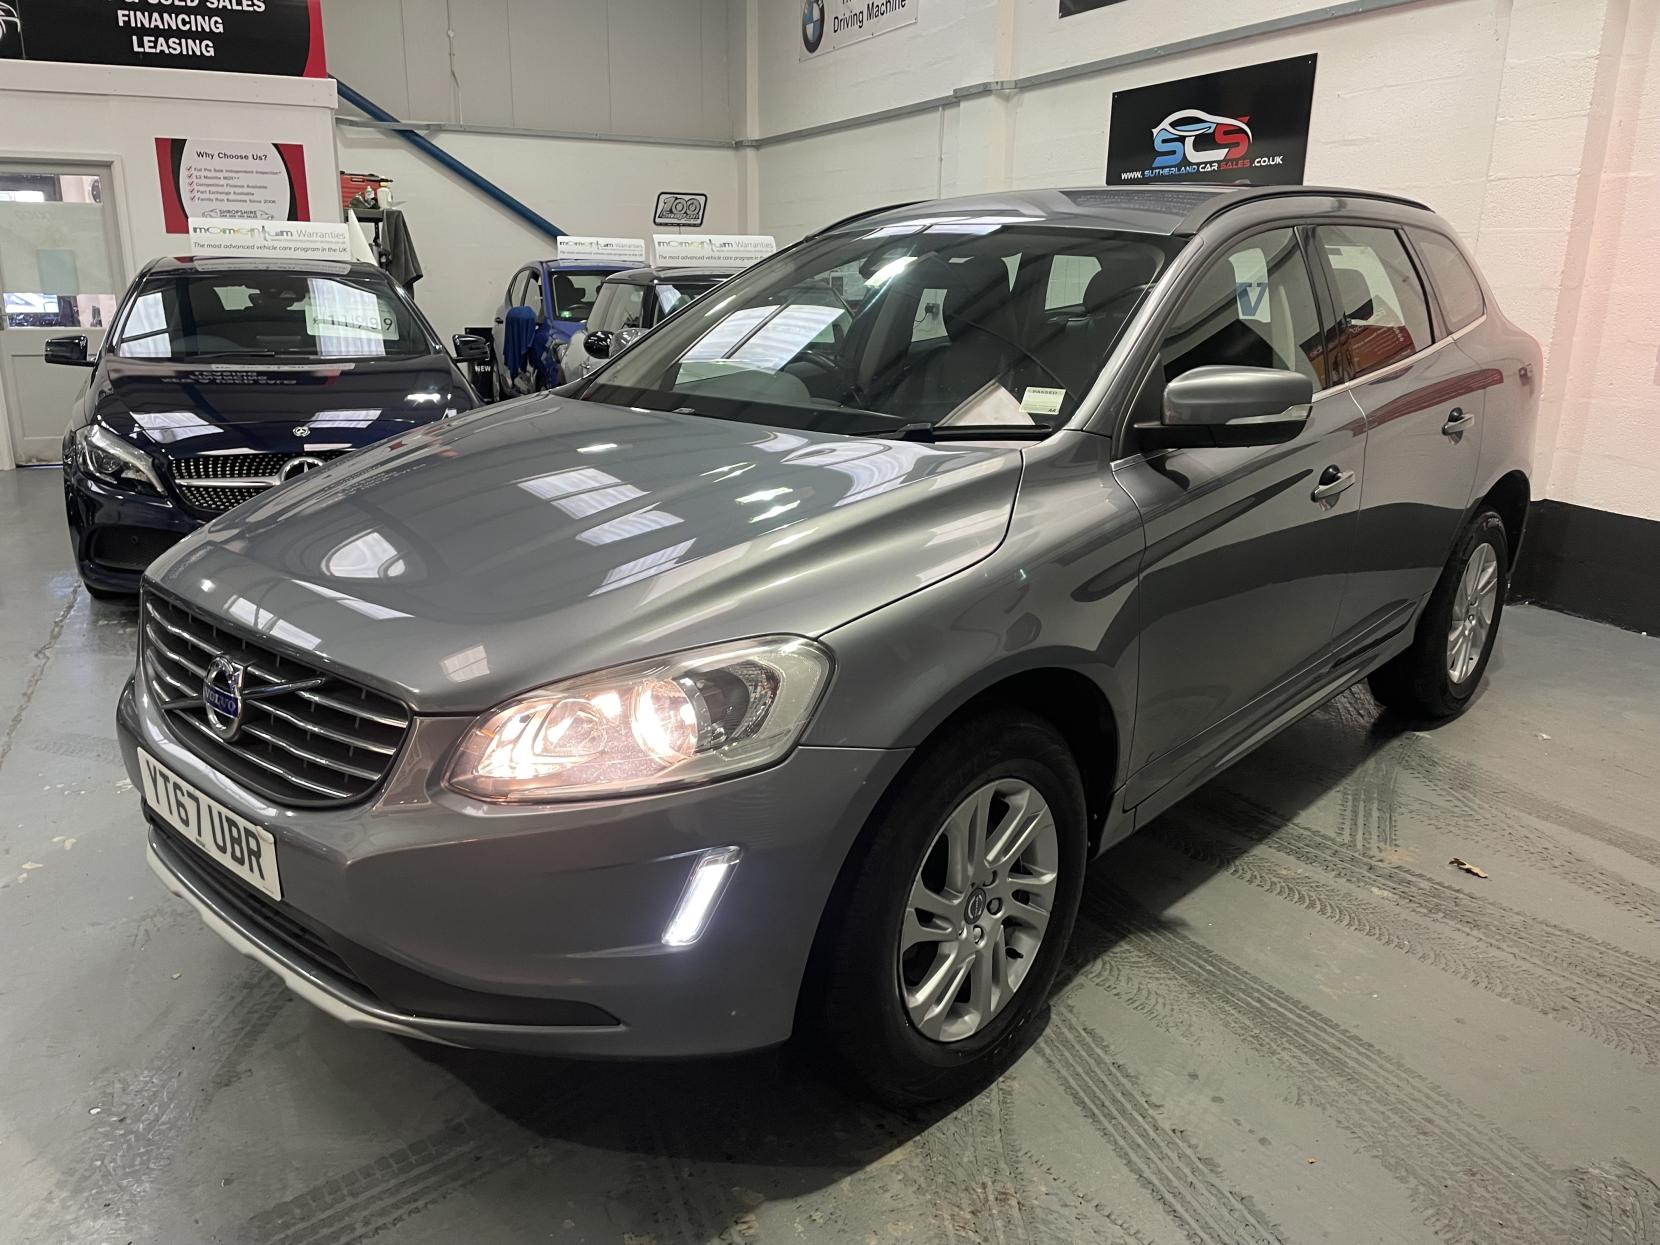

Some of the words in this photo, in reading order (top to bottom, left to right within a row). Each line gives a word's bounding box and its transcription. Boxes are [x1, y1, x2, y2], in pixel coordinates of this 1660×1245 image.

[206, 0, 266, 12] SALES
[833, 10, 863, 33] Driving
[866, 0, 906, 21] Machine
[117, 9, 224, 33] FINANCING
[132, 35, 215, 56] LEASING
[1152, 115, 1250, 167] SCS
[196, 151, 214, 160] Why
[217, 152, 249, 160] Choose
[1144, 165, 1198, 178] SUTHERLAND
[1199, 163, 1218, 171] CAR
[1220, 159, 1250, 170] SALES
[1252, 155, 1284, 167] .CO.UK
[659, 196, 701, 216] 100
[295, 229, 346, 240] Warranties
[735, 240, 774, 249] Warranties
[204, 686, 236, 711] VOLVO
[146, 756, 203, 838] YT67
[208, 805, 266, 881] UBR
